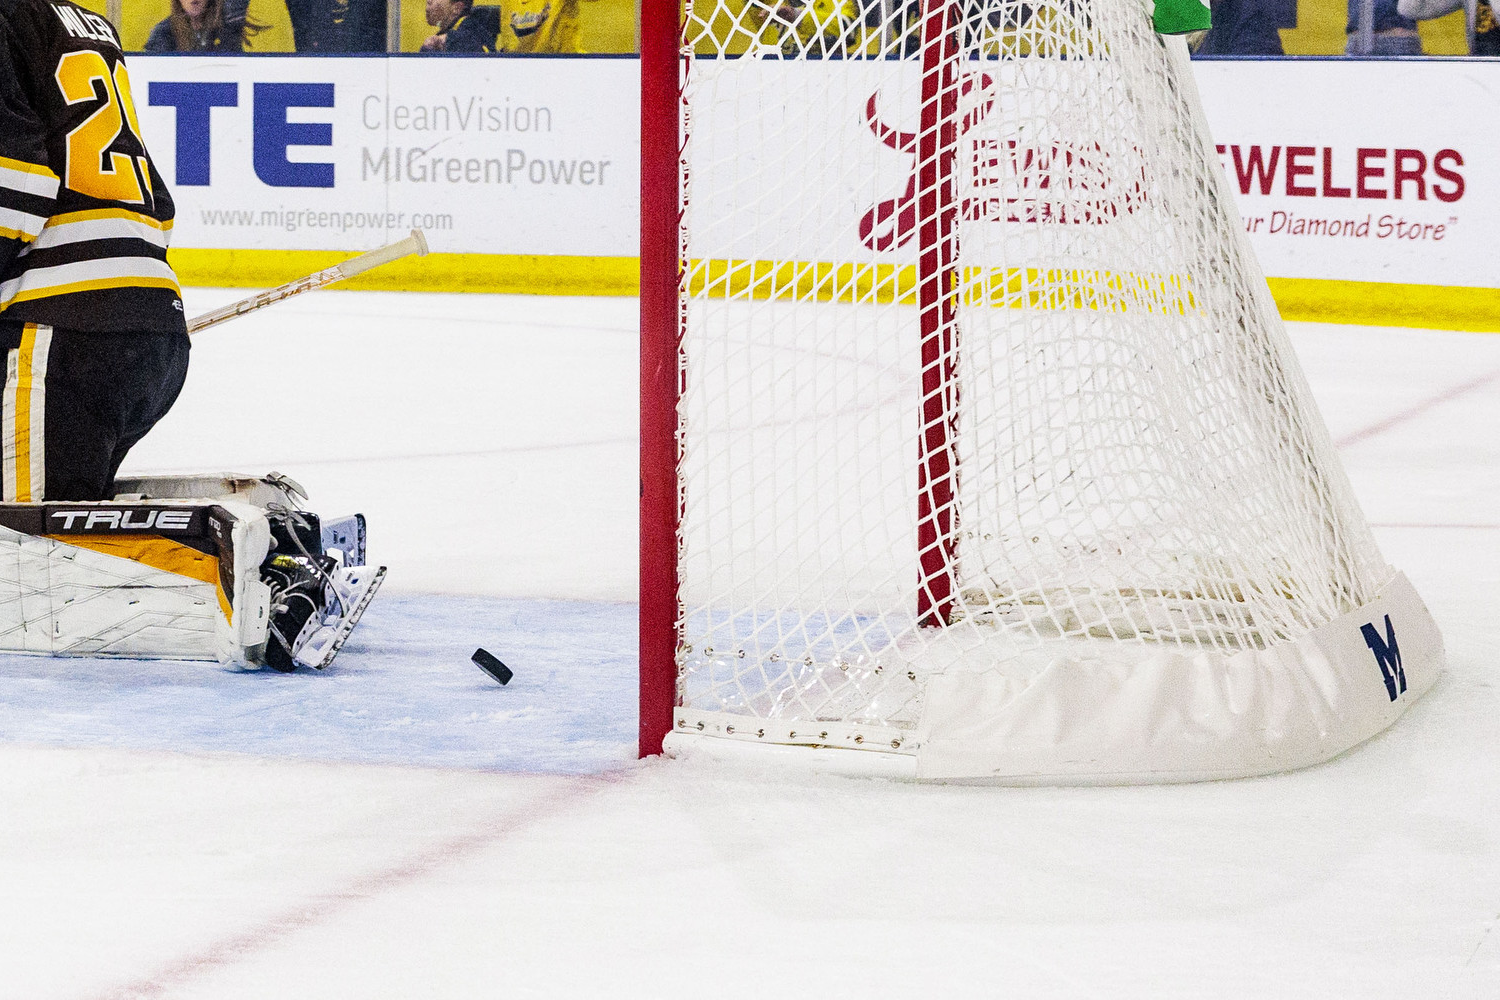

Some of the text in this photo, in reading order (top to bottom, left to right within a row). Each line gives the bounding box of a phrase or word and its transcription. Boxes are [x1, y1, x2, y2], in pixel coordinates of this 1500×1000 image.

[361, 94, 553, 133] CleanVision
[360, 146, 611, 187] MIGreenPower
[200, 205, 454, 233] www.migreenpower.com
[1269, 210, 1372, 239] Diamond
[51, 510, 194, 530] TRUE
[1360, 613, 1407, 702] M
